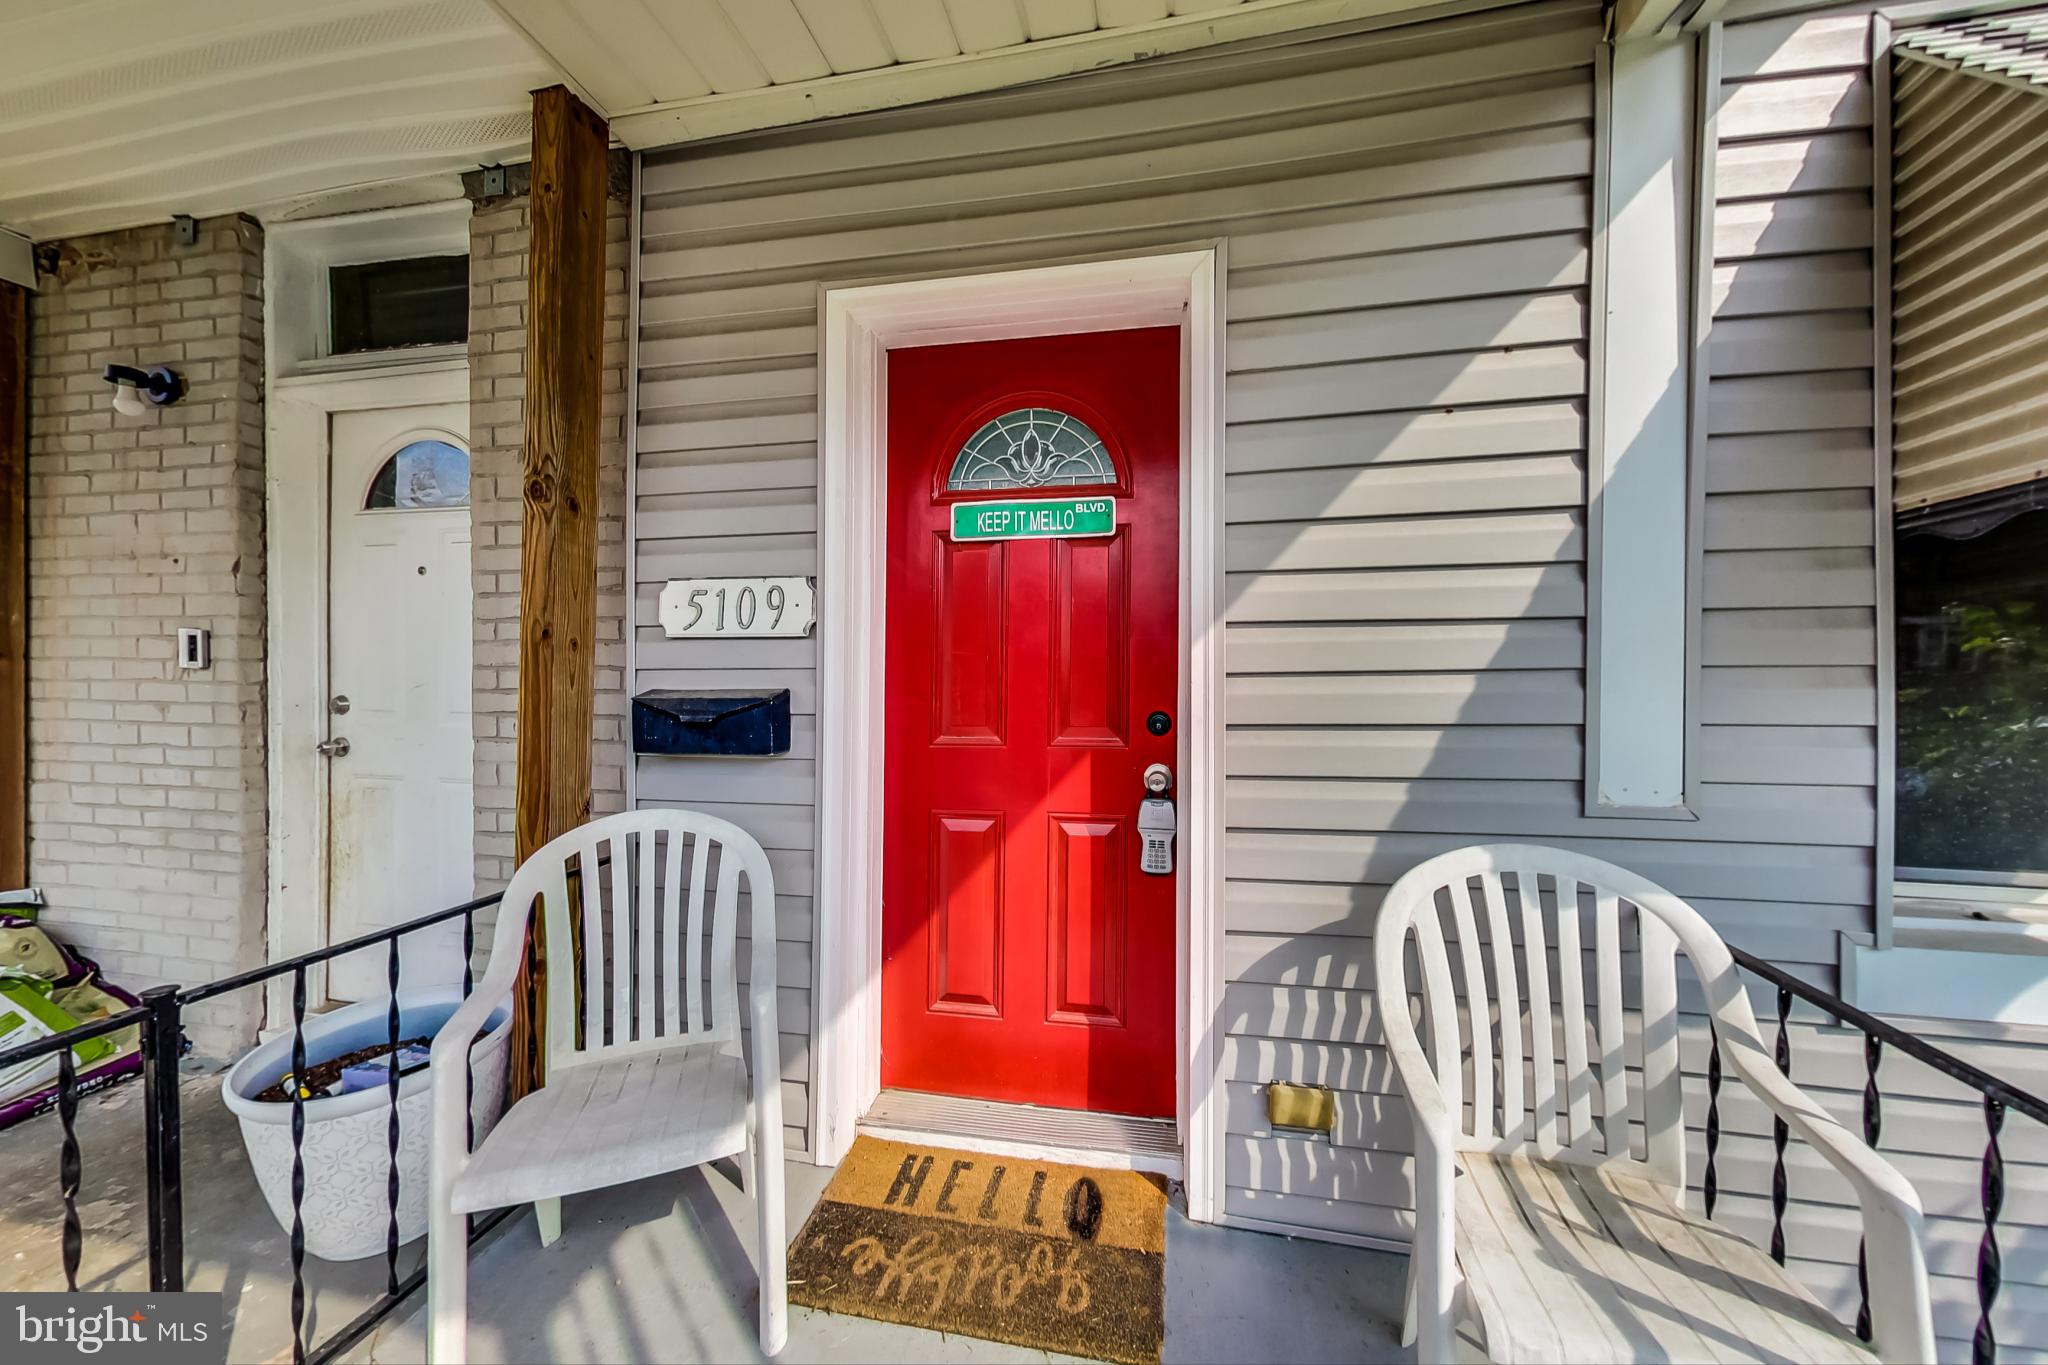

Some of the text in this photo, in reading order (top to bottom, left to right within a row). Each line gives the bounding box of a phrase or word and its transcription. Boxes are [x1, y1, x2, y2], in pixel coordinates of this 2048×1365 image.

[977, 502, 1109, 533] KEEP IT MELLO BLVD.
[683, 584, 785, 632] 5109
[883, 1152, 1103, 1241] HELLO
